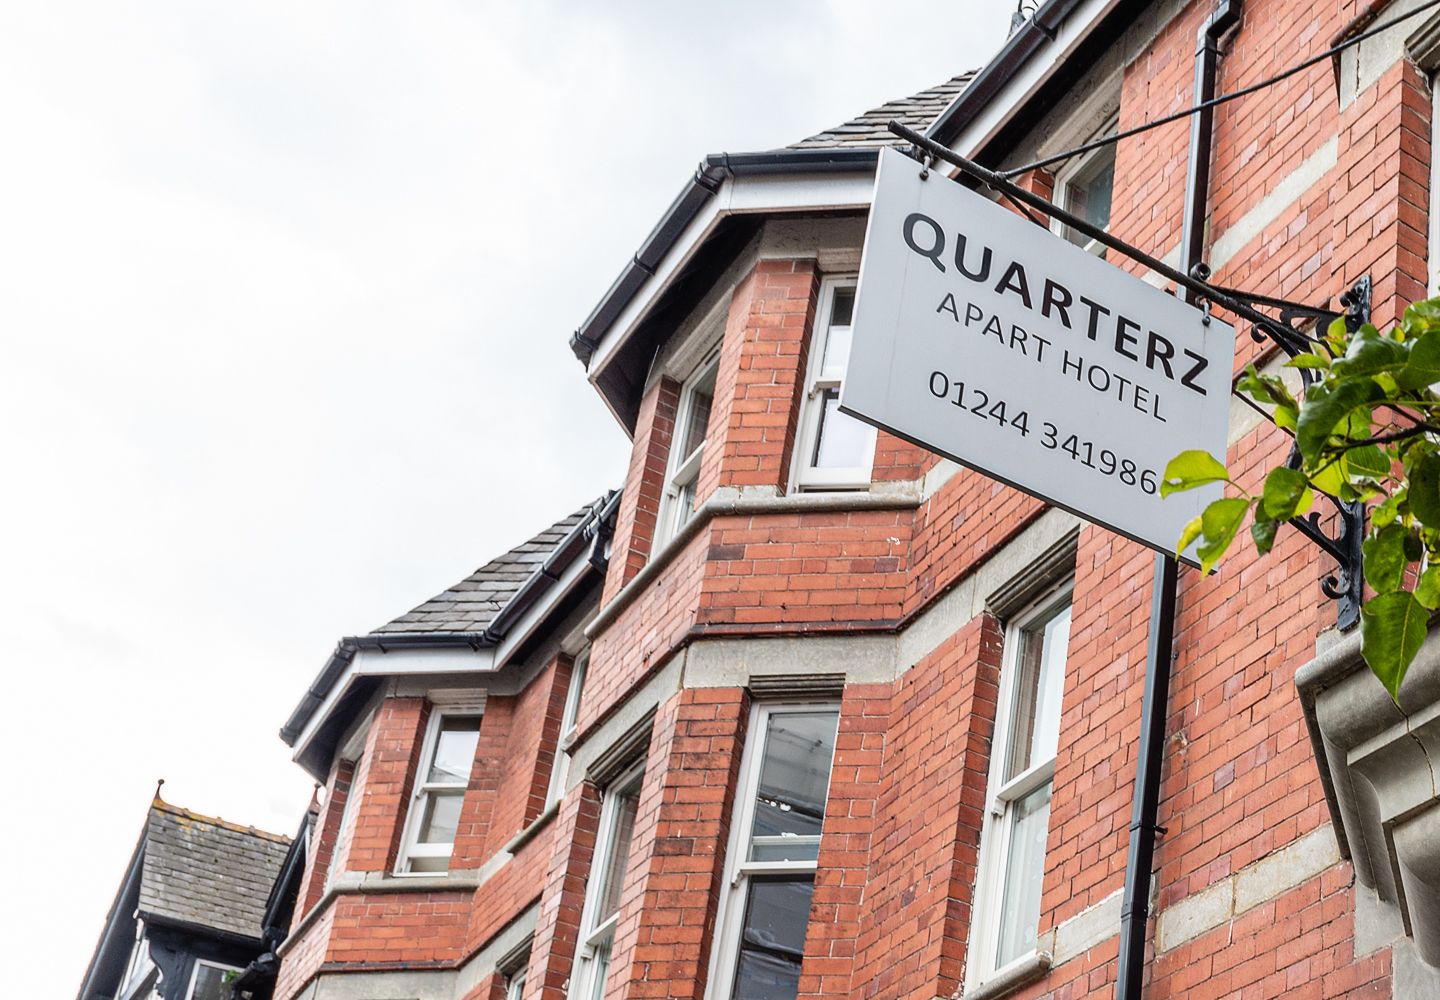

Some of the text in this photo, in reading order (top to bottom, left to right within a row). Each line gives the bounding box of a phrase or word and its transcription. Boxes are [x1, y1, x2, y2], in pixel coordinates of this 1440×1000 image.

[902, 212, 1210, 397] QUARTERZ
[936, 292, 1167, 423] APART HOTEL
[929, 370, 1158, 495] 01244 341986
